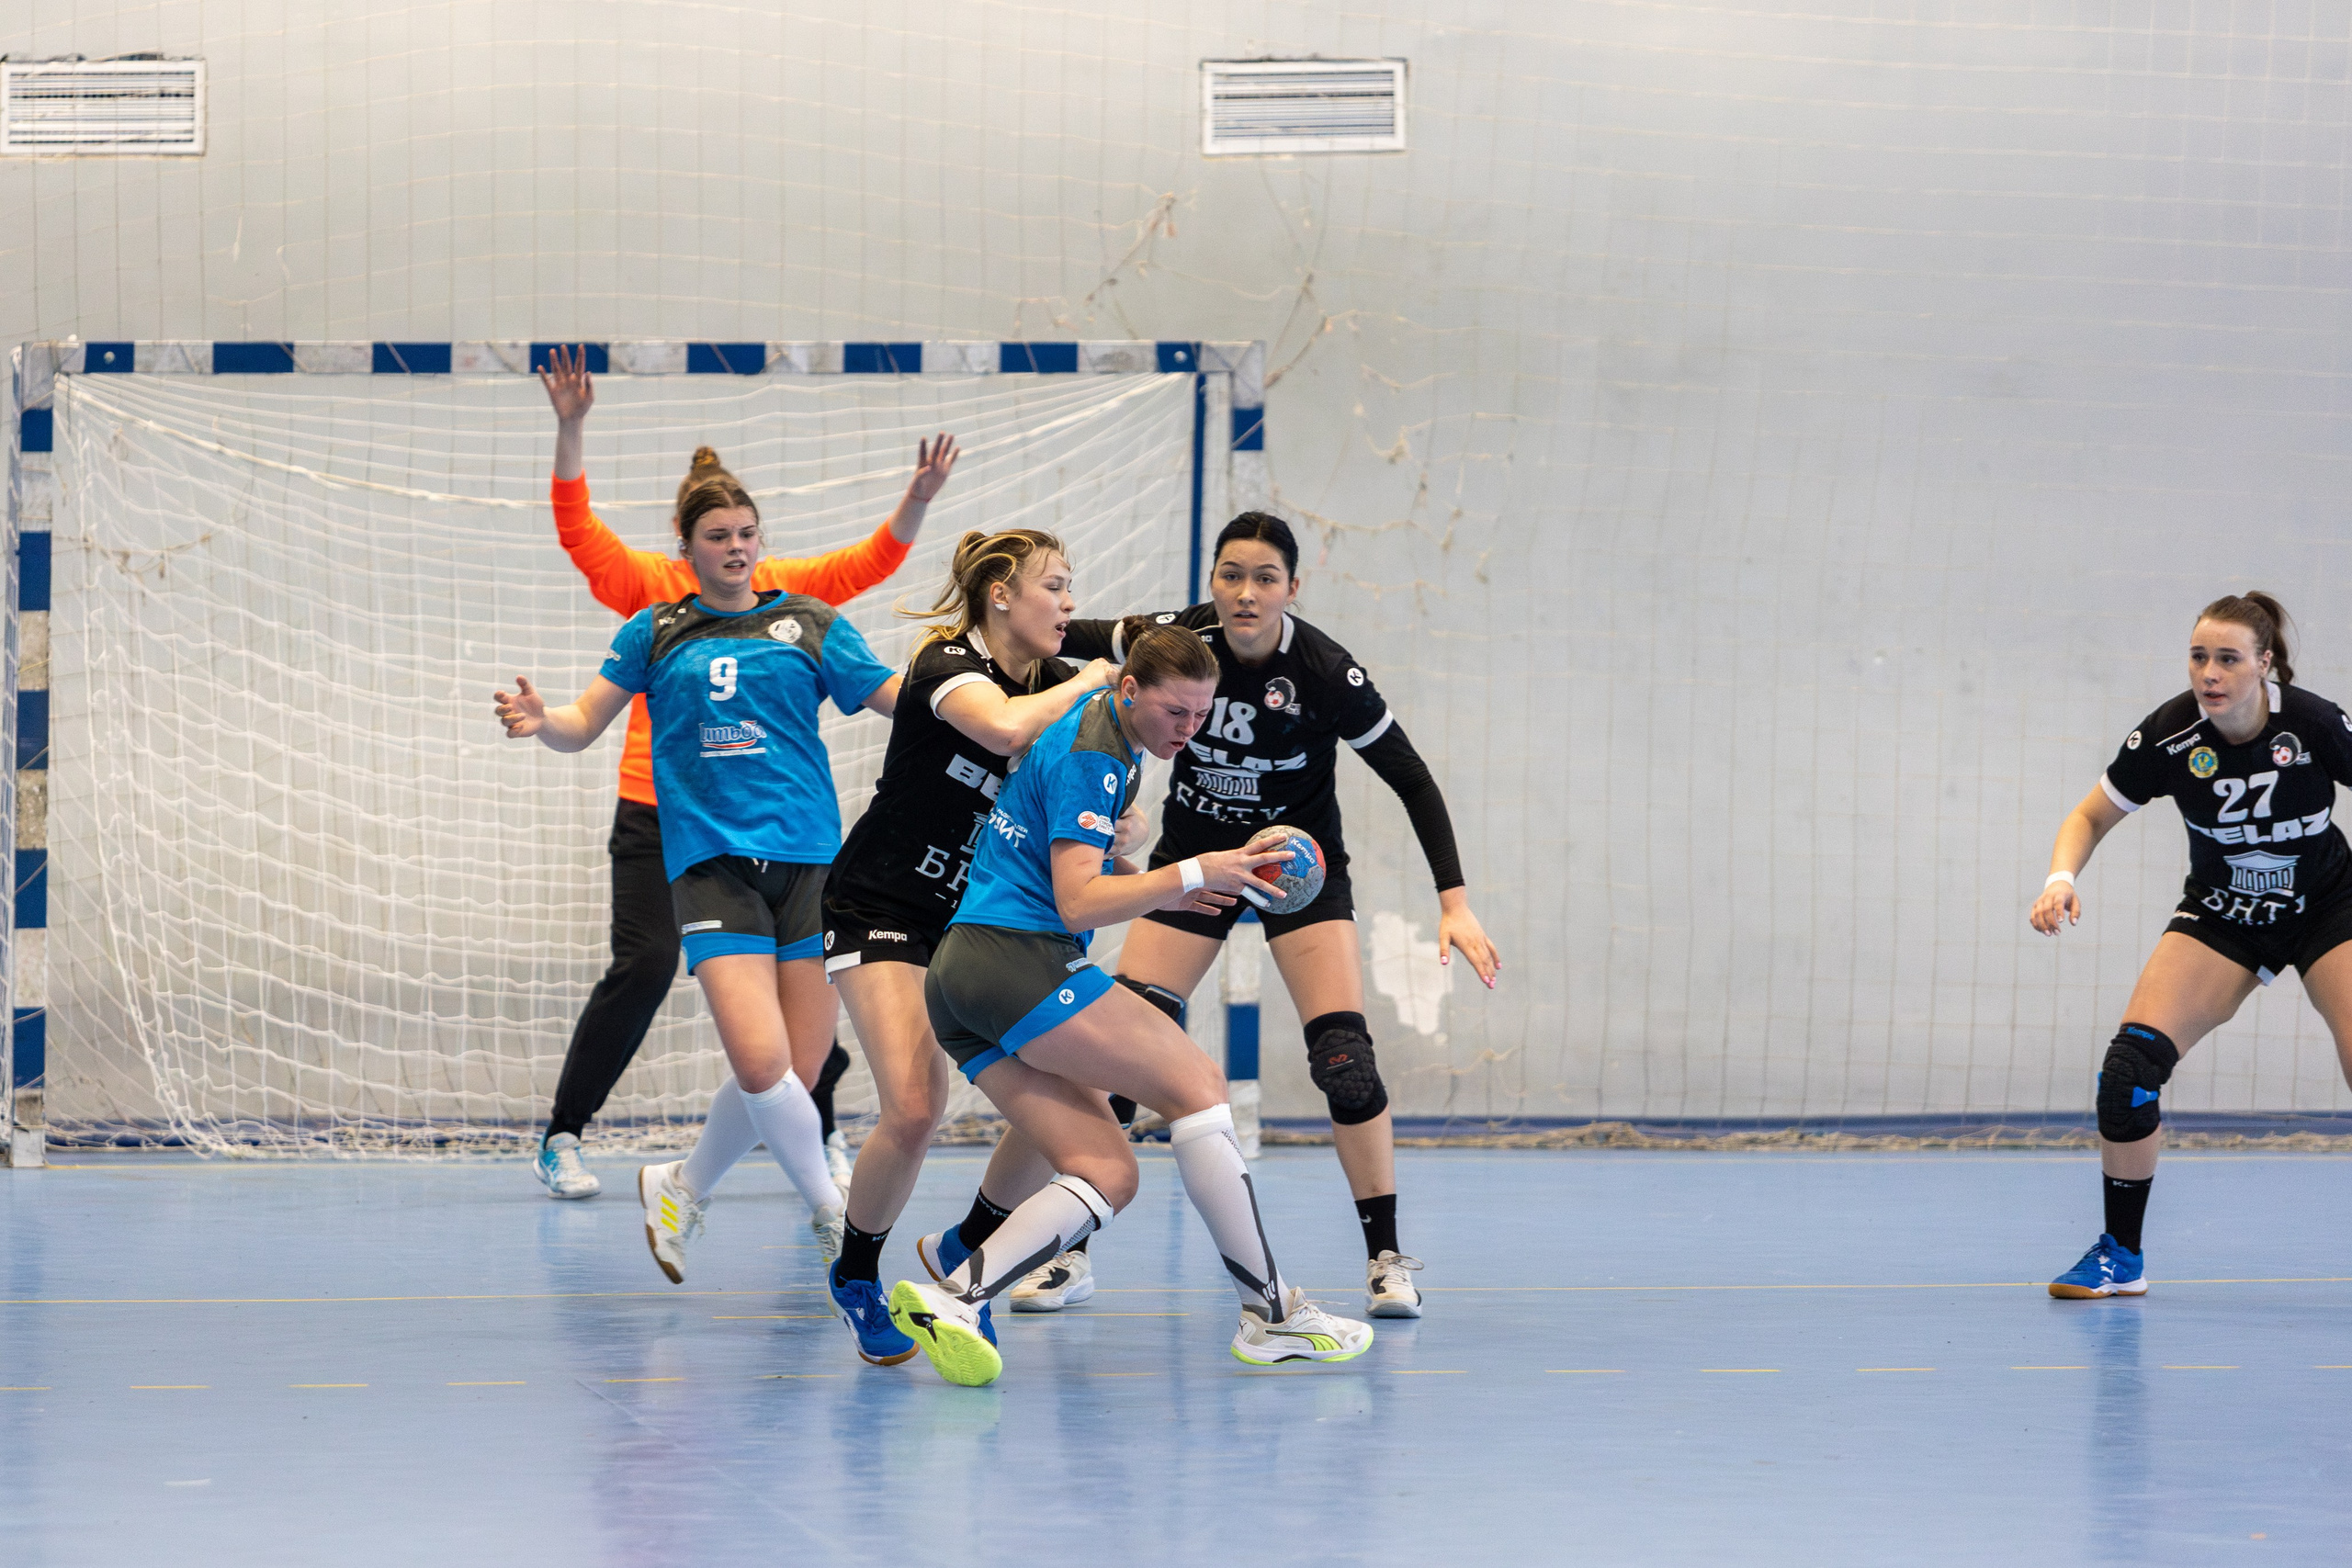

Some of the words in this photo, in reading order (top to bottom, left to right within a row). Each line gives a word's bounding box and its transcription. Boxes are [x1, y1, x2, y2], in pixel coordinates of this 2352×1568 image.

[709, 657, 737, 701] 9
[1206, 696, 1258, 745] 18
[1187, 739, 1307, 771] ELAZ
[2166, 733, 2201, 755] Kempa
[2212, 771, 2278, 823] 27
[2185, 807, 2331, 844] ELAZ
[1291, 838, 1316, 864] Kempa
[868, 929, 908, 942] Kempa
